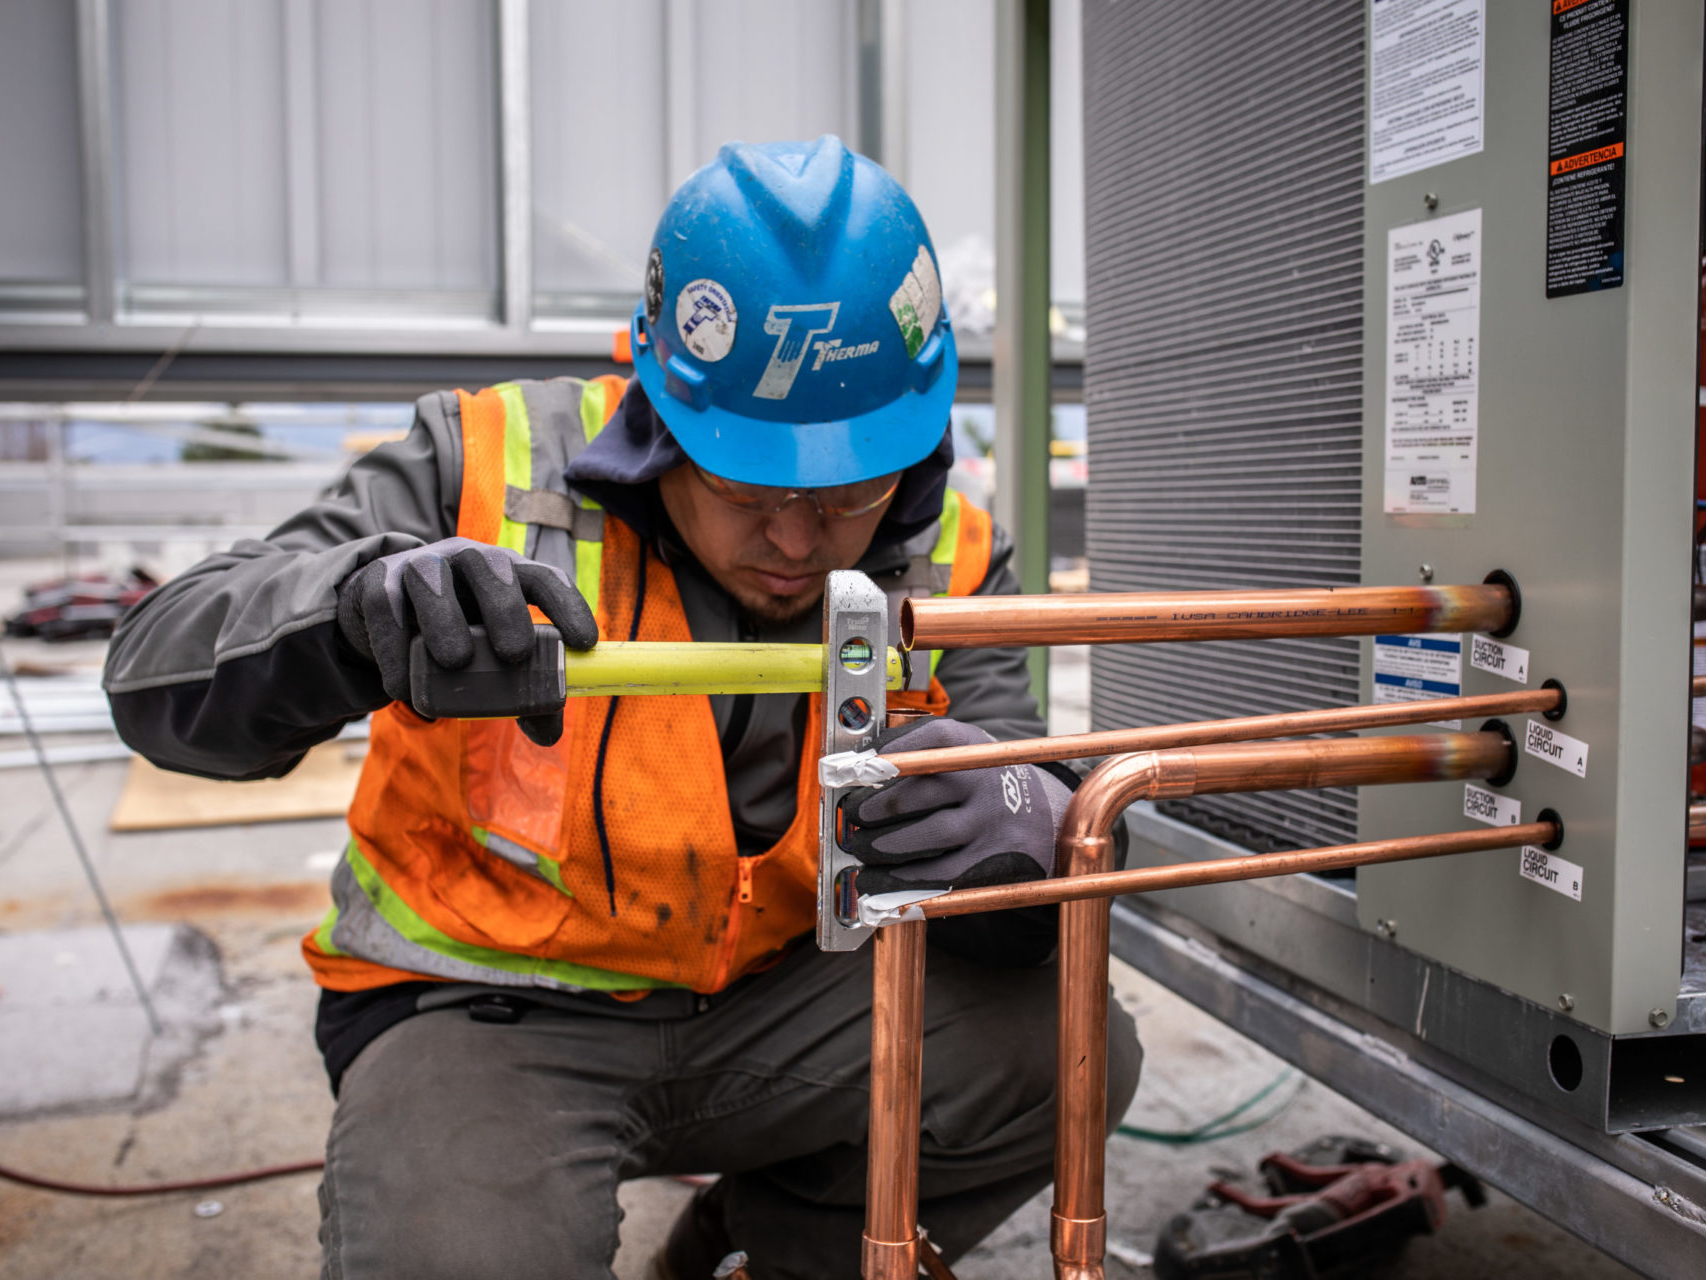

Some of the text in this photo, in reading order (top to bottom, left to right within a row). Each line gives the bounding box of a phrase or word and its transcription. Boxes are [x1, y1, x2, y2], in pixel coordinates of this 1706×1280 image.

[1564, 147, 1617, 169] ADVERTENCIA
[687, 283, 707, 294] SAFETY
[812, 338, 881, 372] THERMA
[1172, 612, 1216, 621] IUSA
[1226, 607, 1370, 620] CAMBRIDGE-LEE
[1474, 639, 1504, 657] SUCTION
[1473, 649, 1507, 671] CIRCUIT
[1518, 664, 1525, 675] A
[1528, 722, 1554, 742] LIQUID
[1527, 734, 1564, 760] CIRCUIT
[1576, 756, 1583, 767] A
[1466, 787, 1496, 807] SUCTION
[1466, 798, 1498, 820] CIRCUIT
[1523, 847, 1549, 866] LIQUID
[1522, 859, 1560, 884] CIRCUIT
[1572, 881, 1579, 891] B
